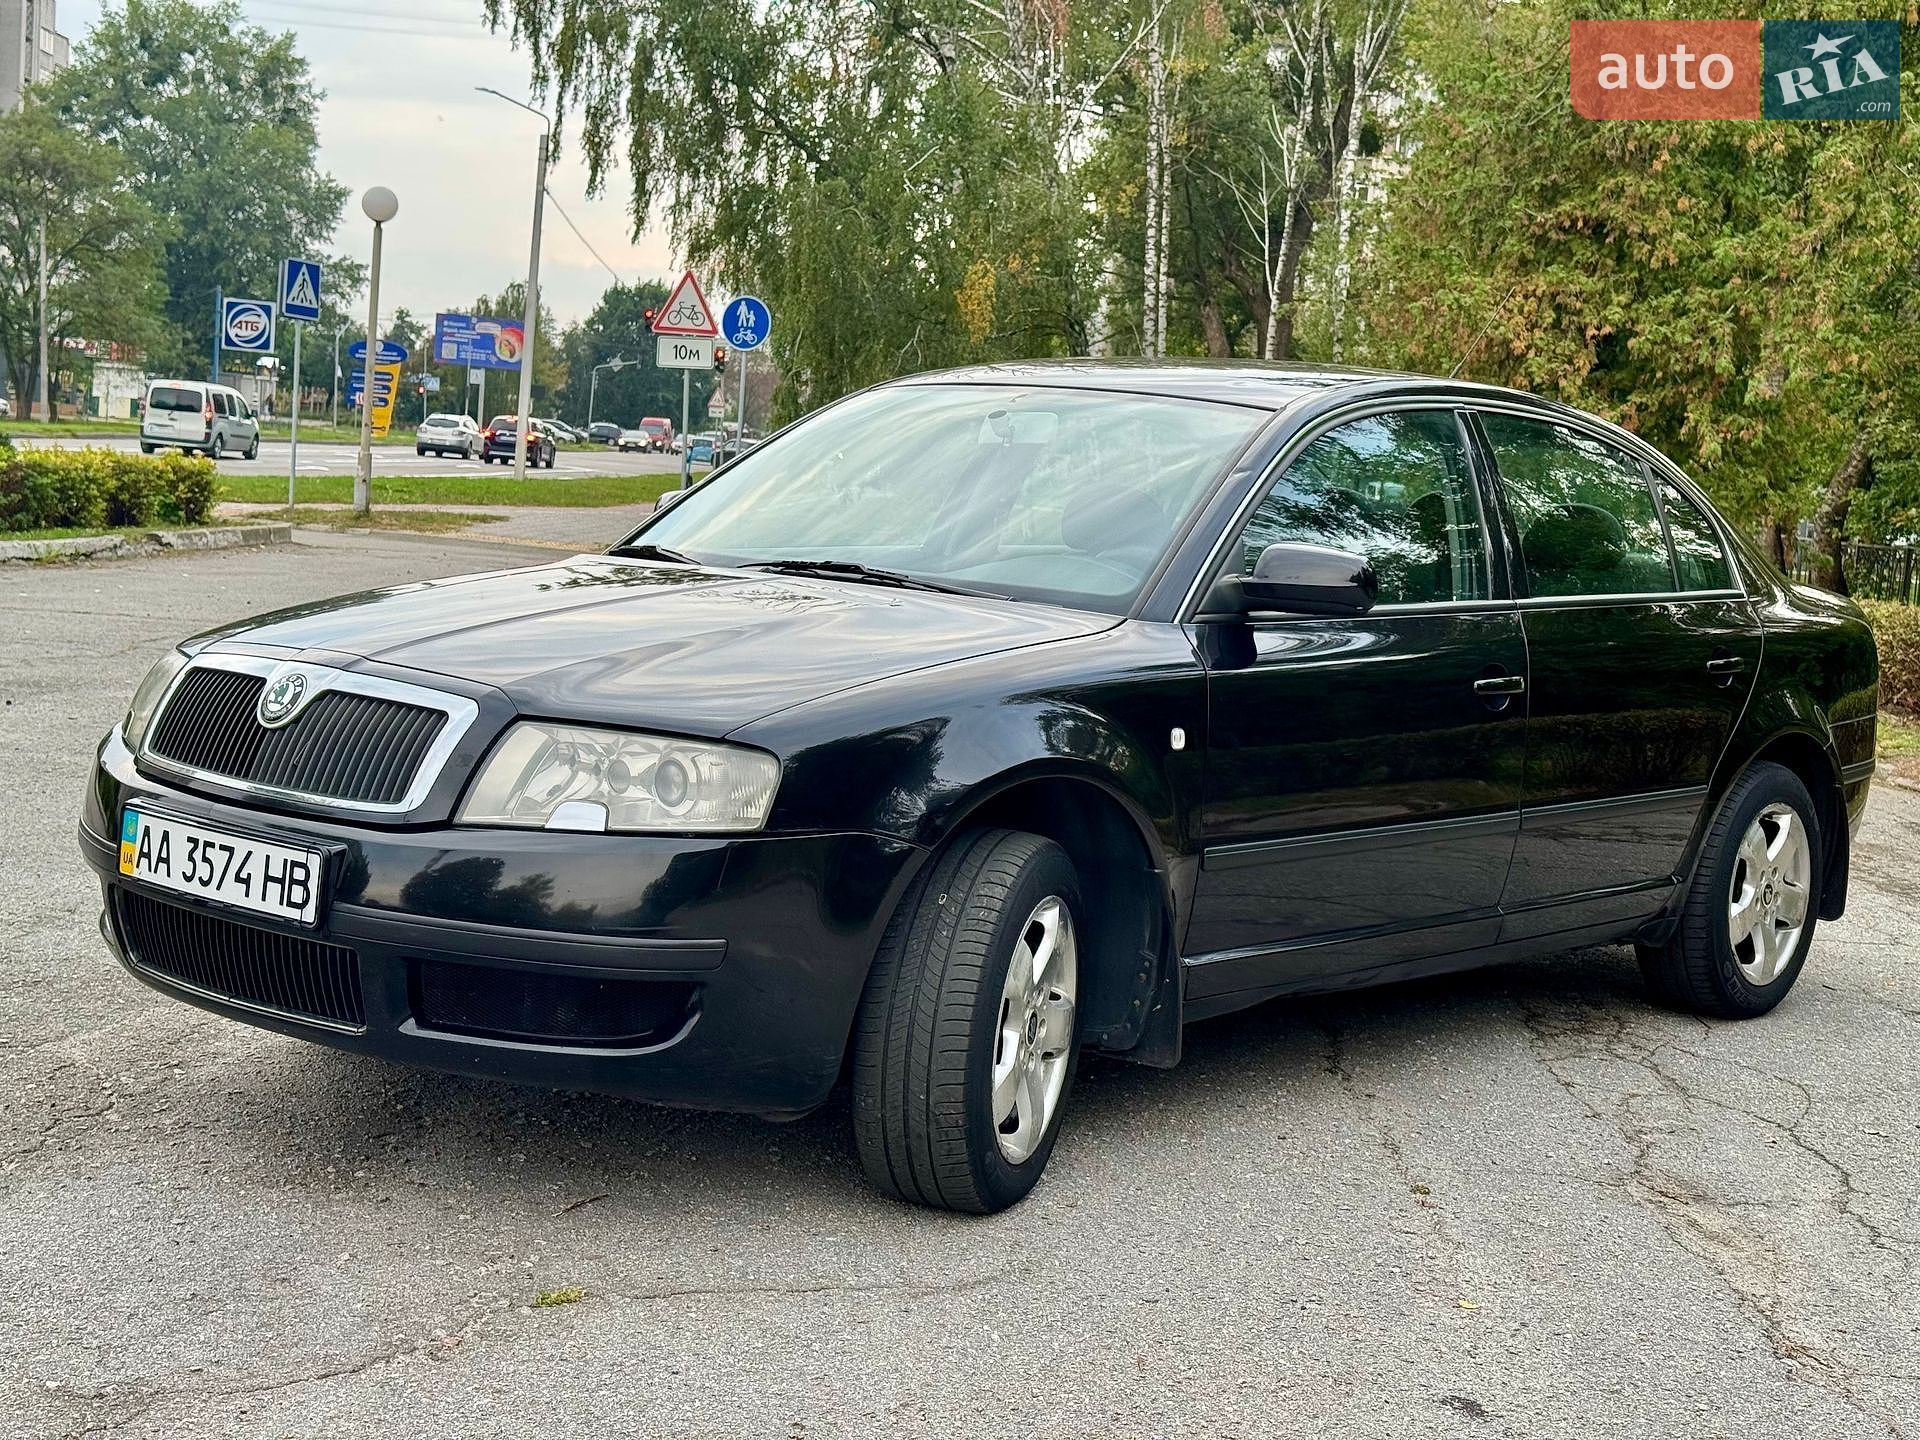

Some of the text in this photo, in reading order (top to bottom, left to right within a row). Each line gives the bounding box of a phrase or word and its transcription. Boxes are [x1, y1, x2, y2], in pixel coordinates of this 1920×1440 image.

[232, 320, 261, 331] АТБ
[123, 851, 133, 865] UA
[136, 825, 311, 910] AA 3574 HB
